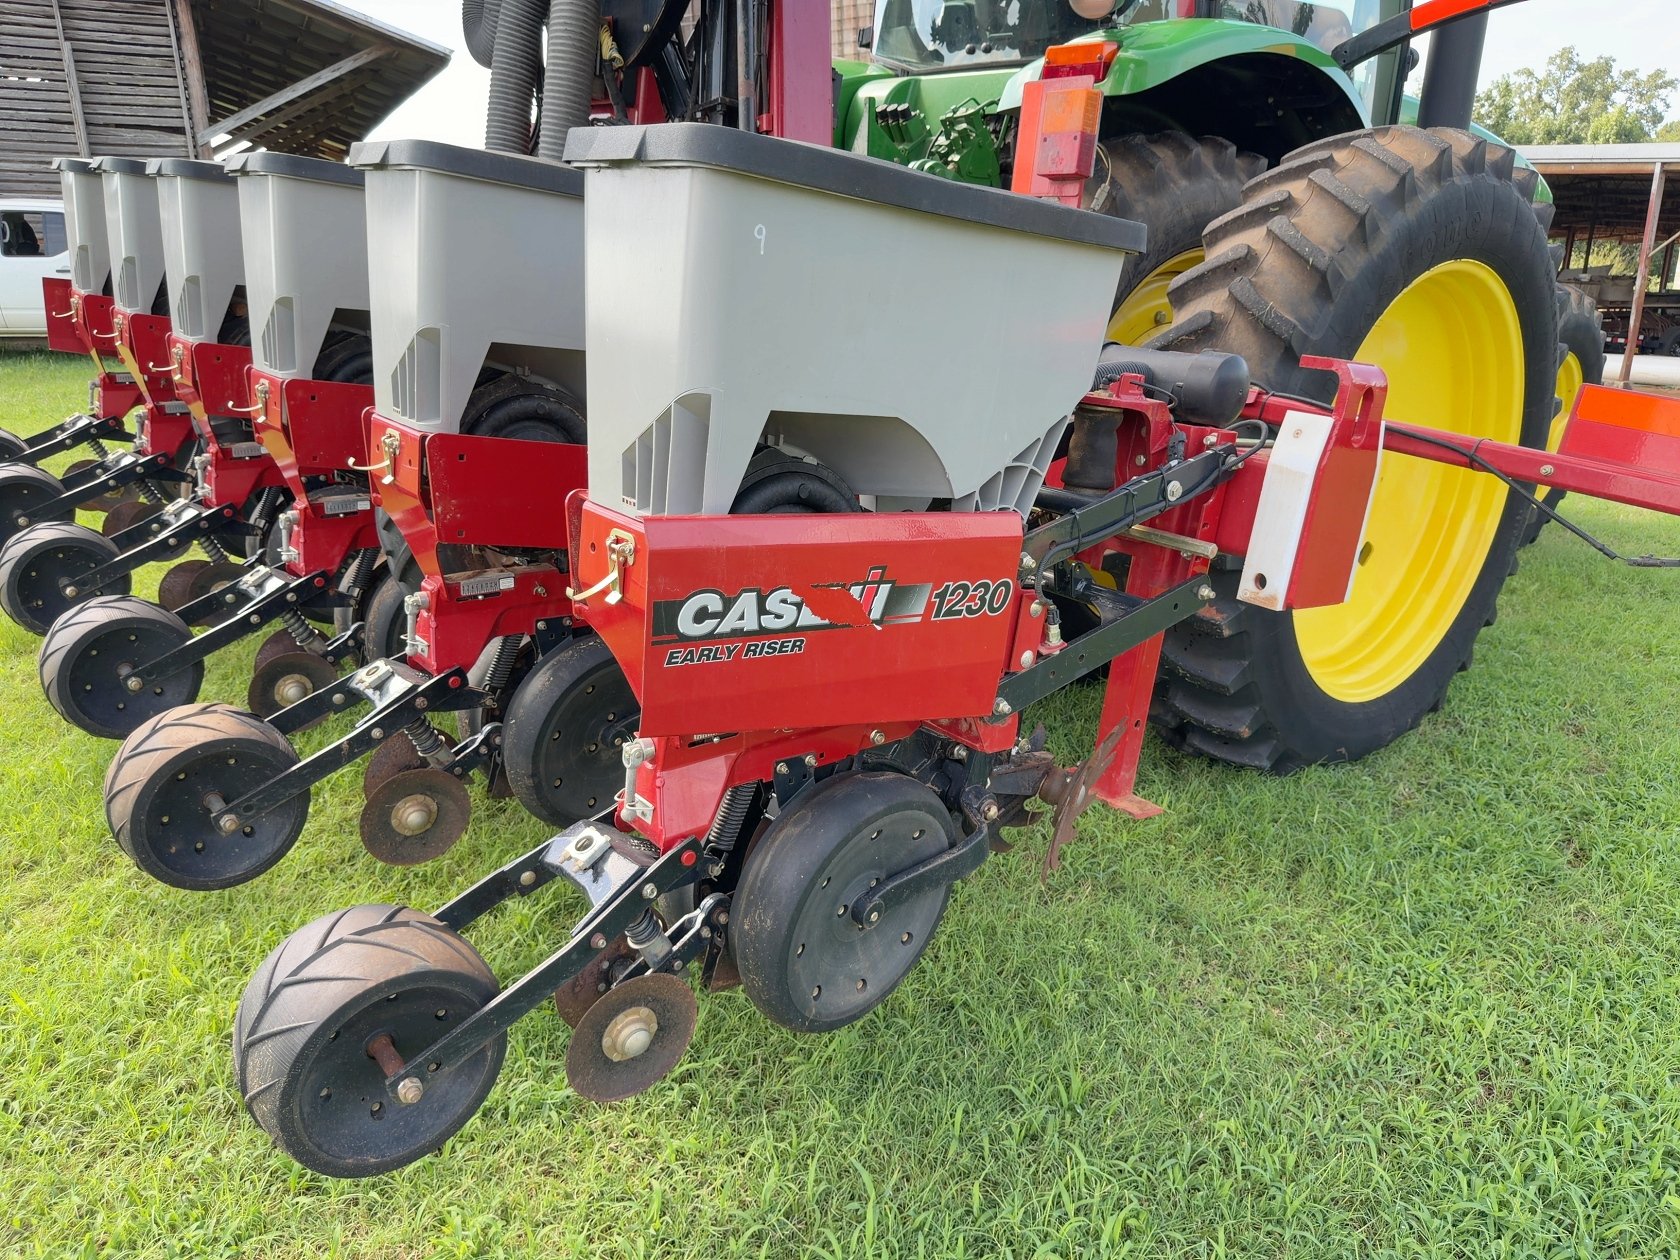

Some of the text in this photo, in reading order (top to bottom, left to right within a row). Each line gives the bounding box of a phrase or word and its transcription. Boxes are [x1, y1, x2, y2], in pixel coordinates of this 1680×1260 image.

[754, 224, 766, 255] 9
[931, 578, 1013, 621] 1230
[664, 638, 806, 667] EARLY RISER
